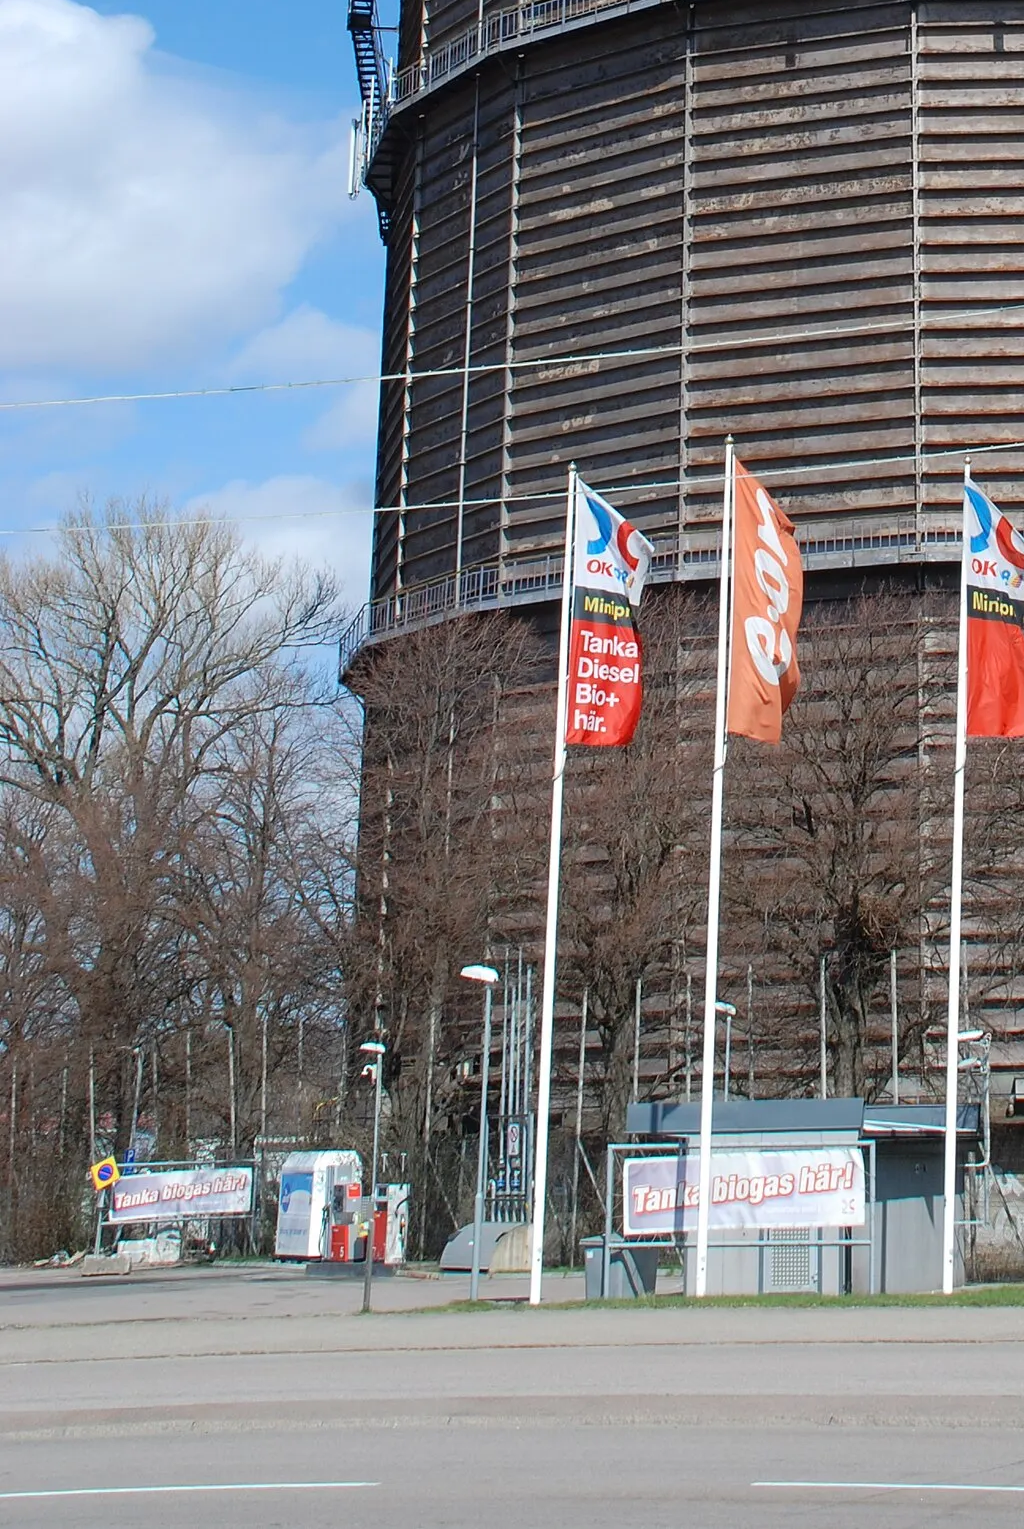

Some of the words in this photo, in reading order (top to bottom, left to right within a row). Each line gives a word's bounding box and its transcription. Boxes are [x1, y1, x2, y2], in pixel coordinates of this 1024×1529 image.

[580, 630, 639, 658] Tanka
[577, 656, 640, 683] Diesel
[575, 683, 620, 707] Bio+
[574, 709, 607, 732] här.
[115, 1189, 159, 1210] Tanka
[162, 1181, 211, 1201] biogas
[213, 1174, 247, 1193] här!
[712, 1172, 794, 1205] biogas
[798, 1161, 855, 1194] här!
